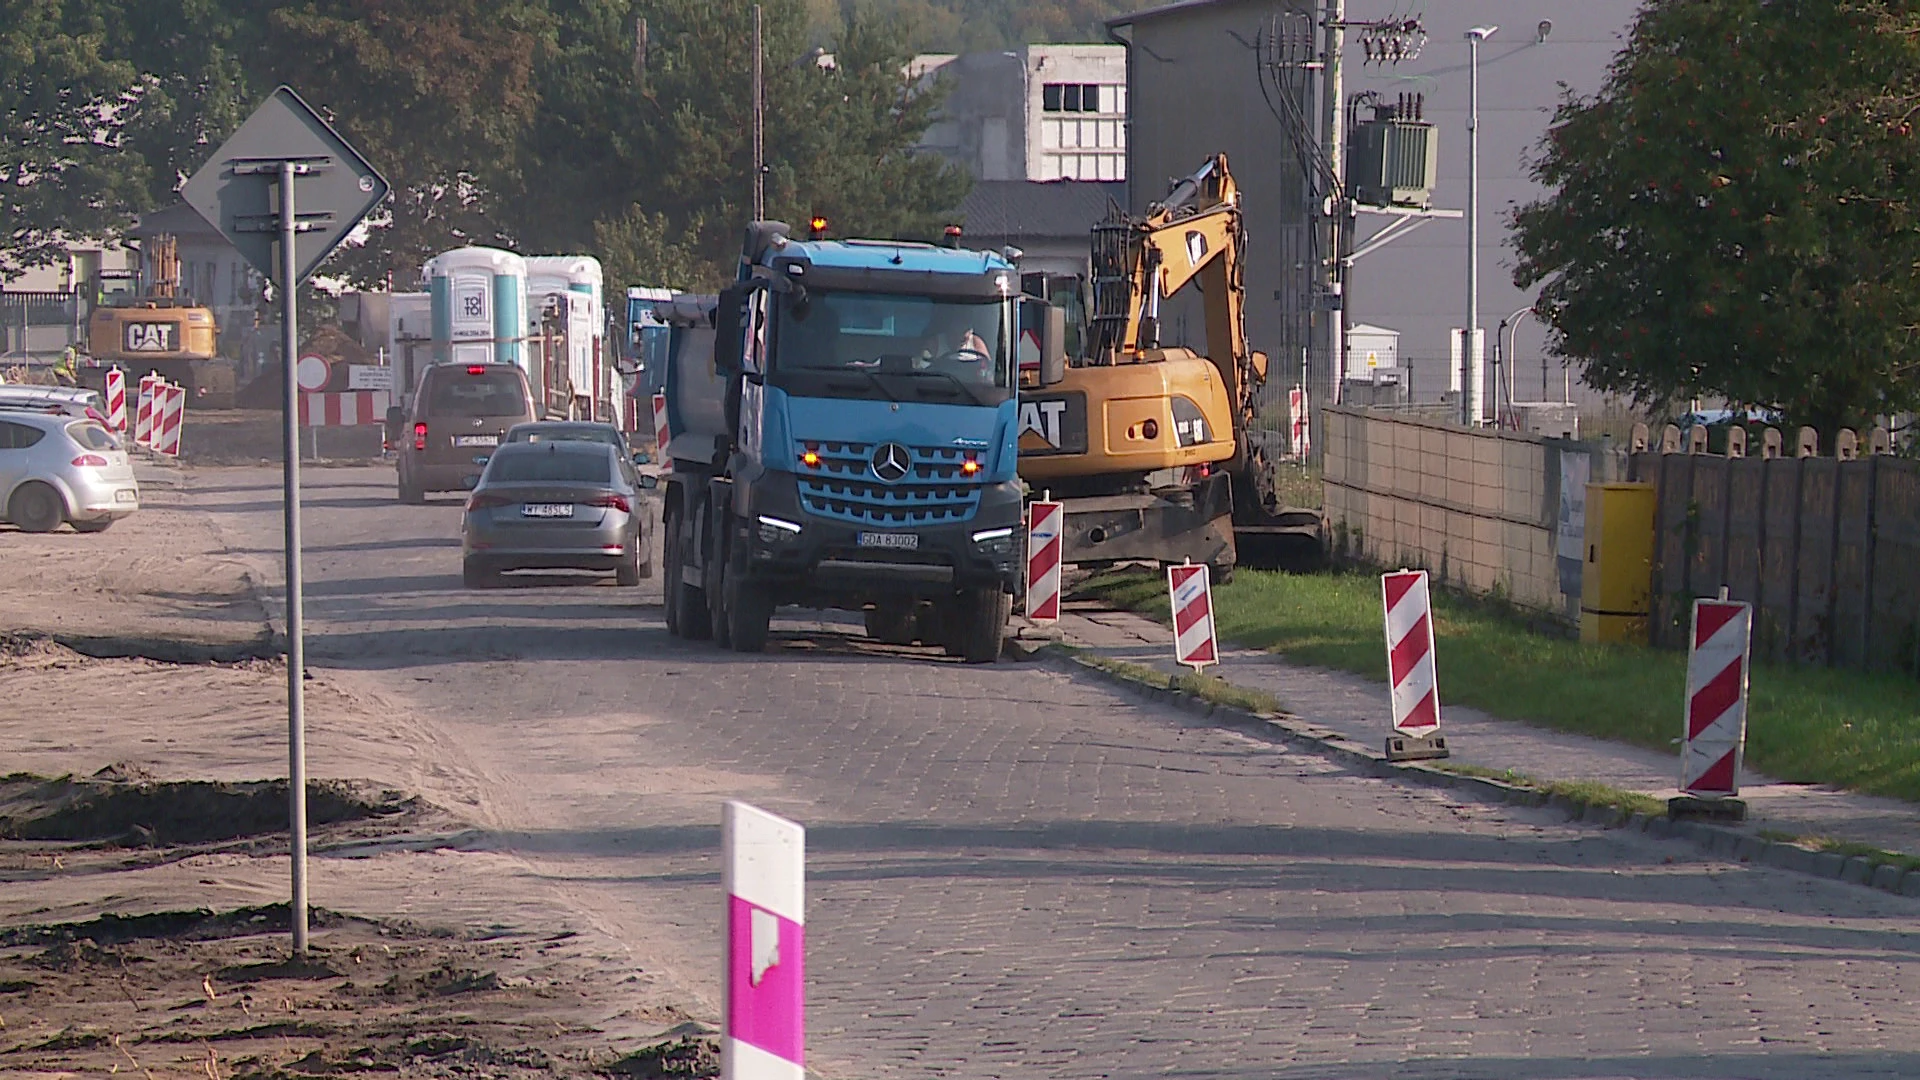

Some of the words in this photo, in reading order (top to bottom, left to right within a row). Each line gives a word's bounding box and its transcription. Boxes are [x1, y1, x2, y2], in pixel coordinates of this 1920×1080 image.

[128, 324, 172, 350] CAT
[1017, 400, 1066, 449] AT
[862, 534, 882, 545] GDA
[885, 534, 917, 548] 83002
